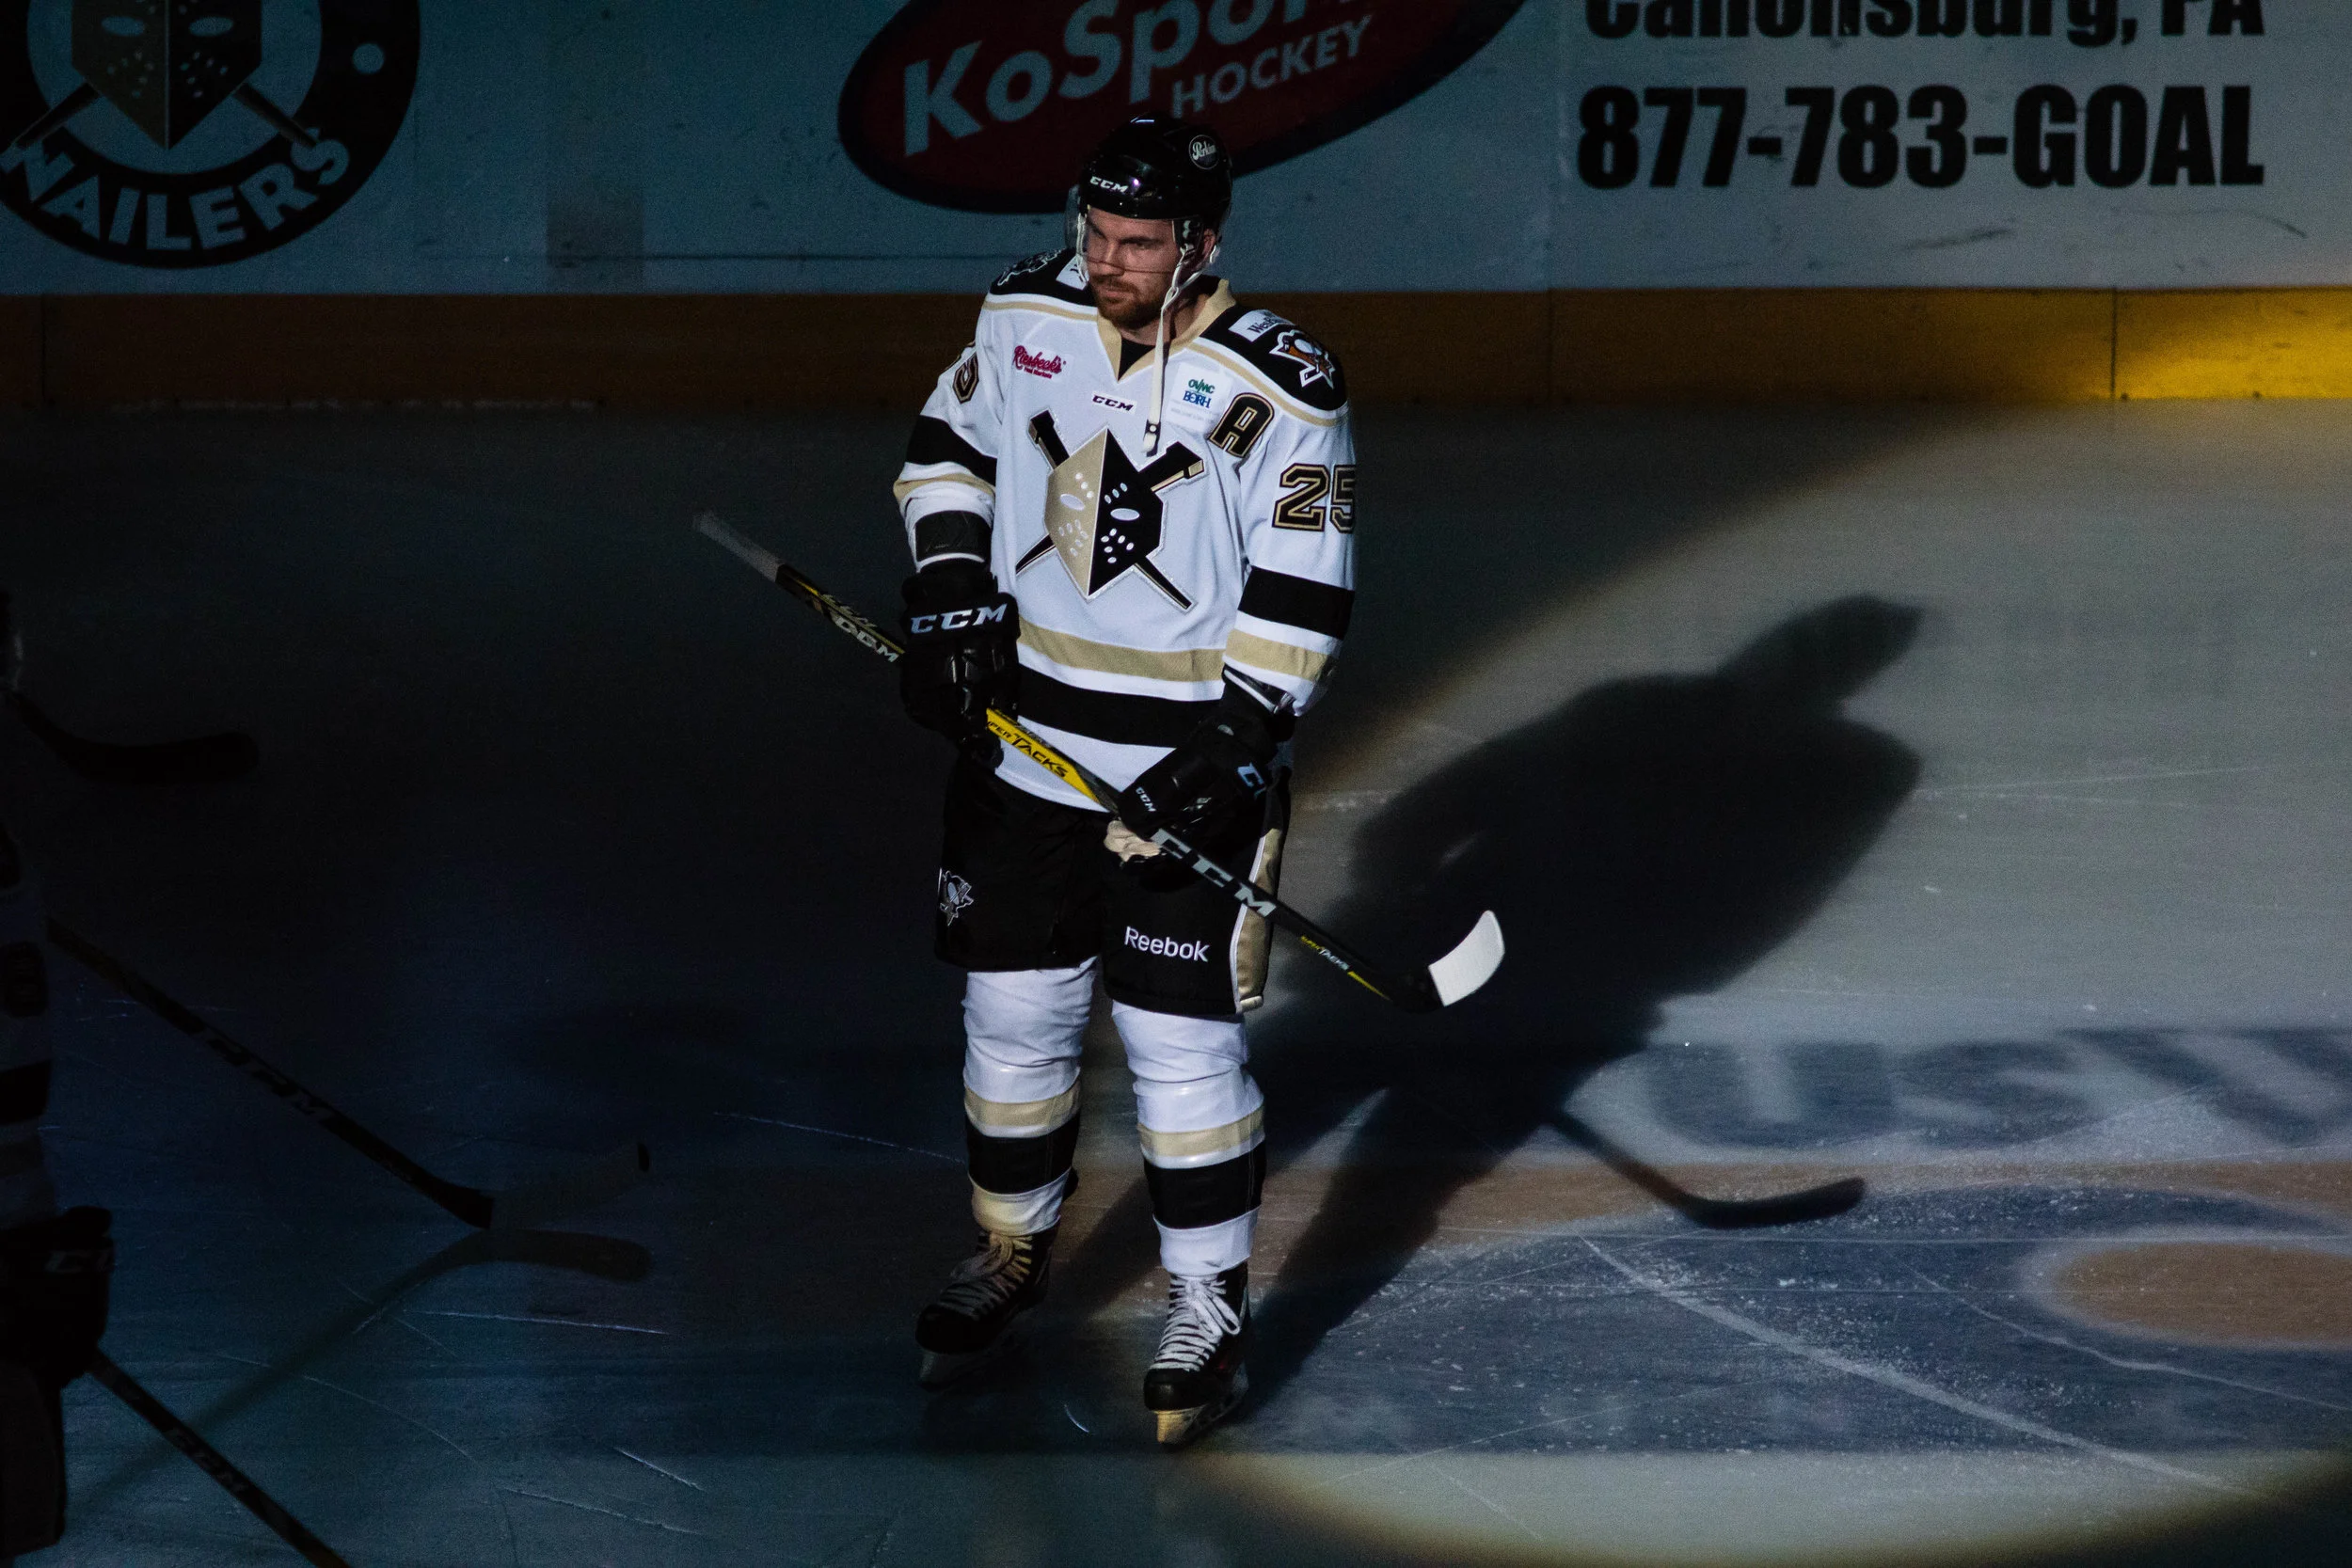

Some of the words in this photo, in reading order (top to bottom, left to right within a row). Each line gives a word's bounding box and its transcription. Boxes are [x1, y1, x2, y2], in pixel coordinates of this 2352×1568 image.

[1170, 15, 1373, 119] HOCKEY
[1578, 85, 2265, 188] 877-783-GOAL
[0, 127, 351, 252] NAILERS
[1089, 175, 1129, 194] CCM
[1092, 395, 1135, 411] CCM
[1207, 392, 1275, 458] A
[1272, 462, 1356, 533] 25
[910, 603, 1009, 635] CCM
[1136, 786, 1157, 812] CCM
[1152, 828, 1278, 917] CCM
[1124, 926, 1211, 963] Reebok
